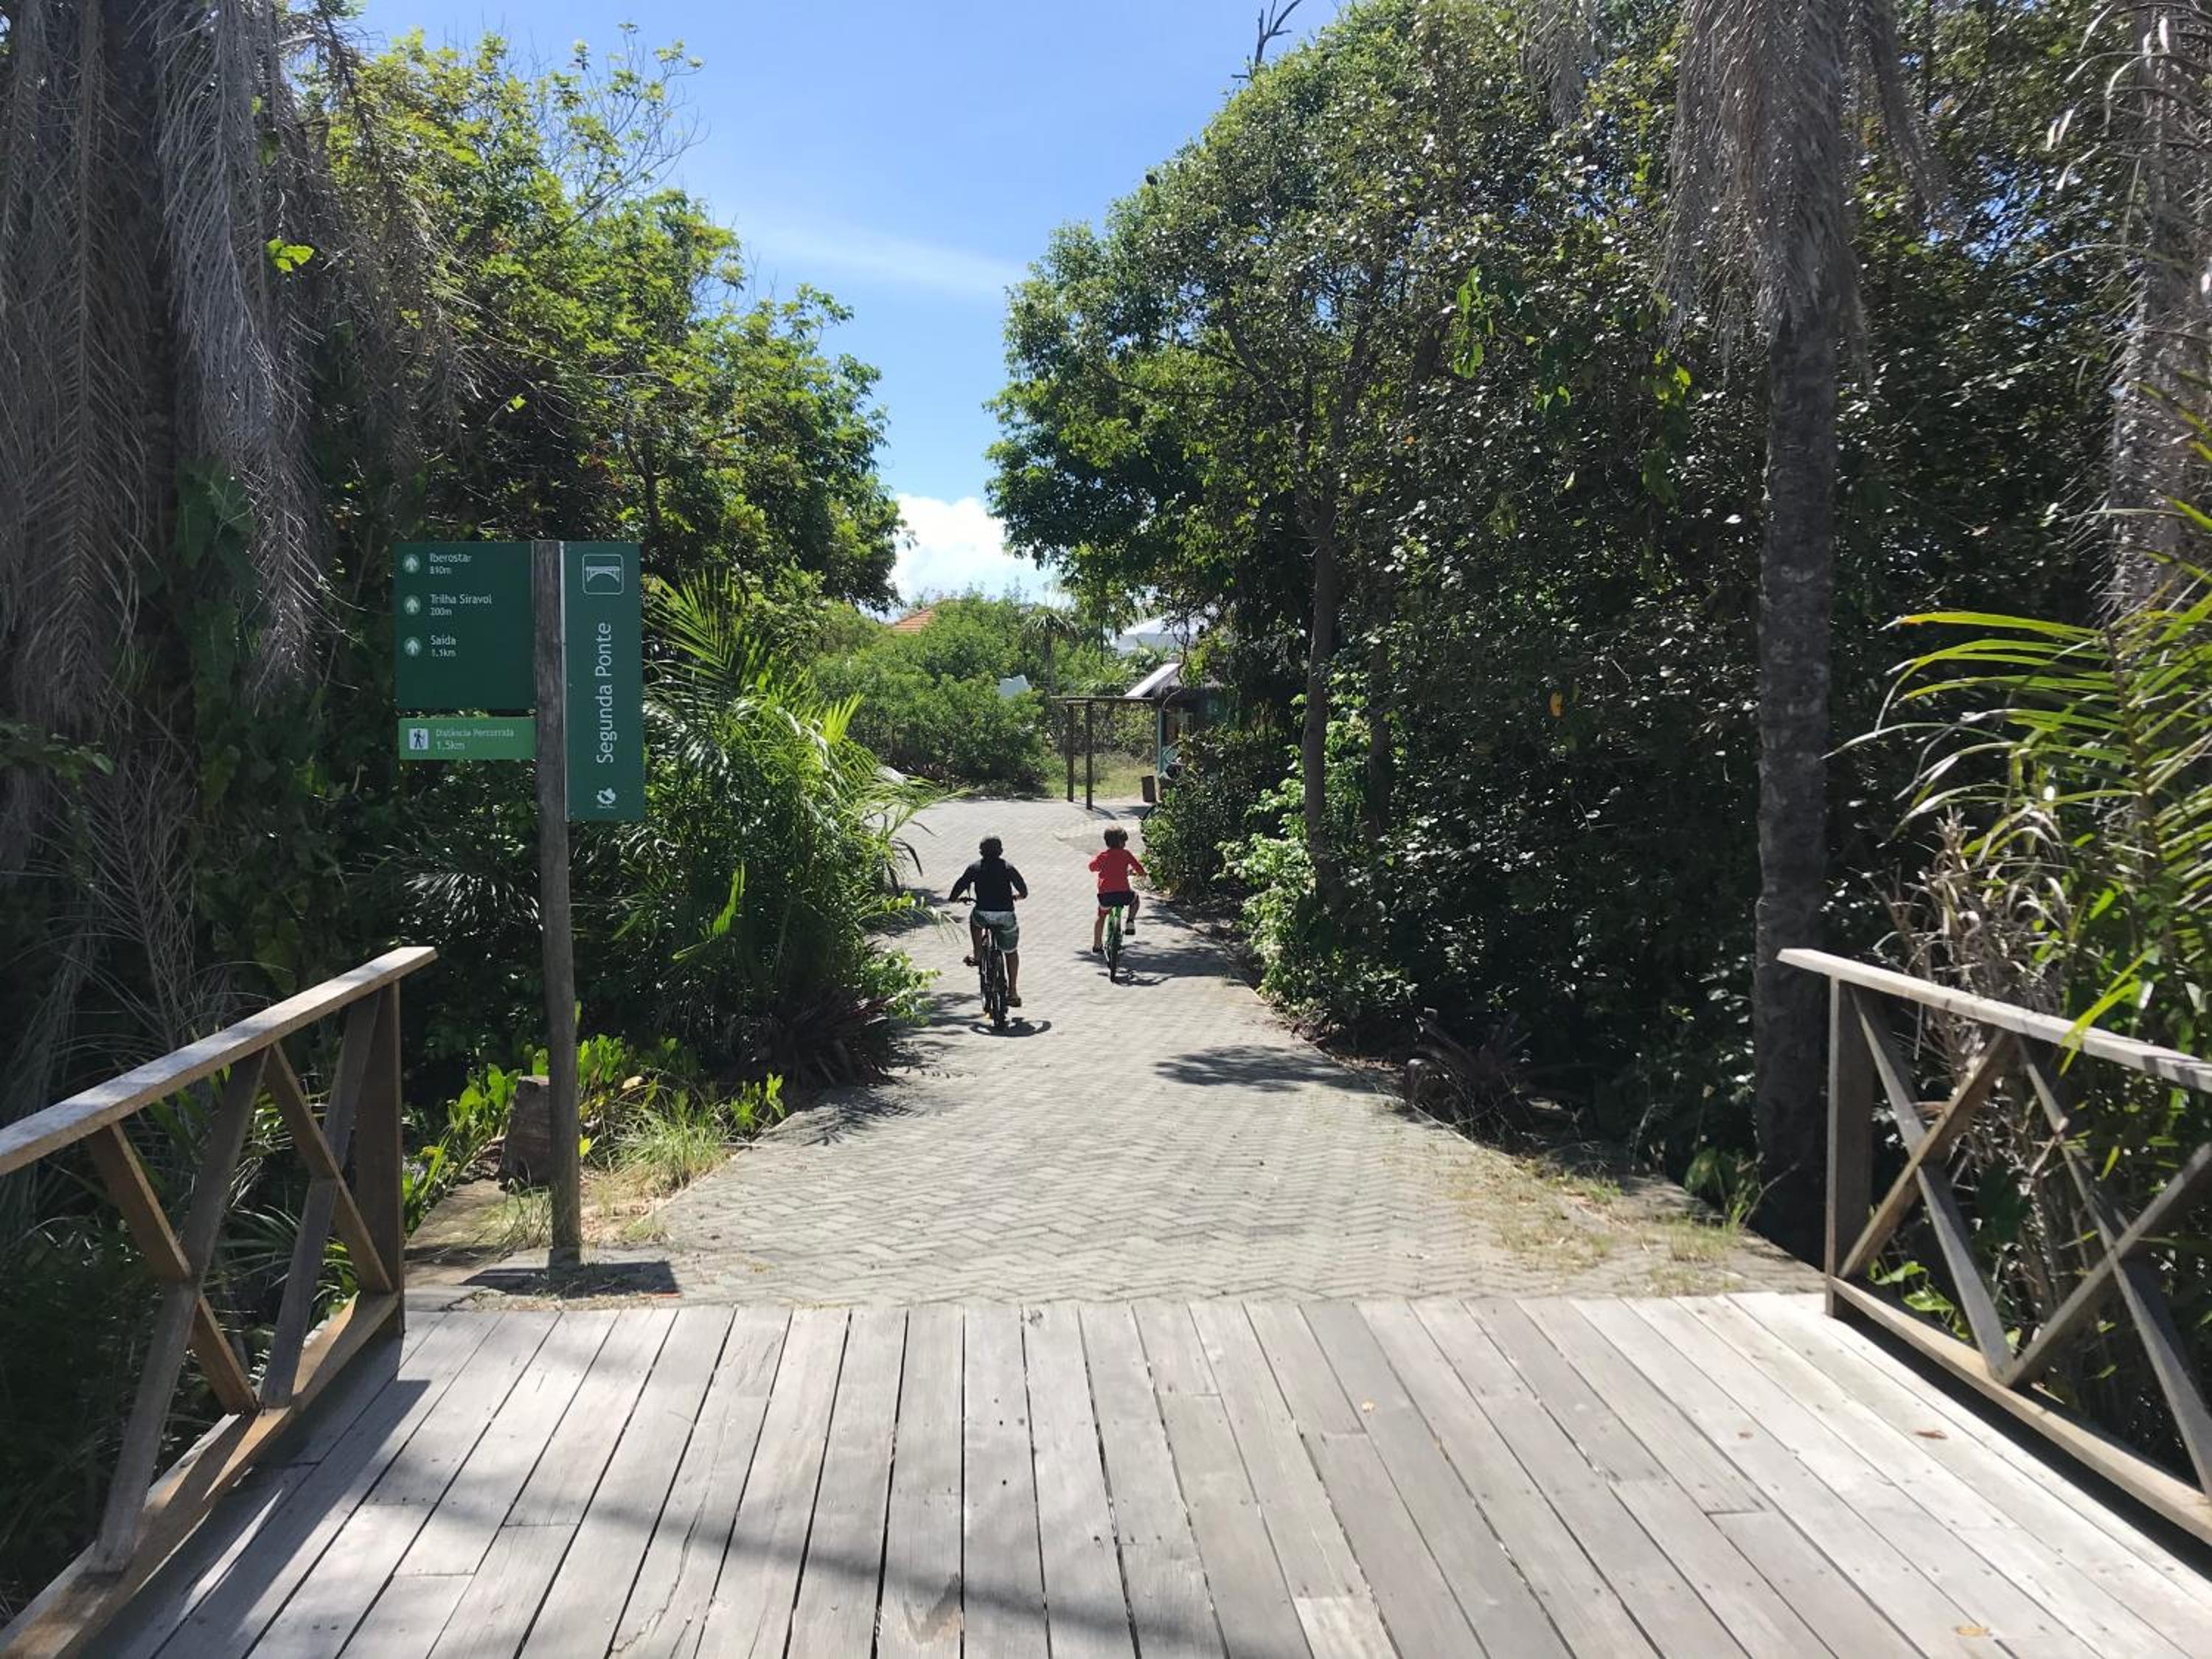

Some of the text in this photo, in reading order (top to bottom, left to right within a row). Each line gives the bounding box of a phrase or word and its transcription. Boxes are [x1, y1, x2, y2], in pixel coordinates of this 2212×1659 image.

[430, 553, 473, 563] Iberostar
[430, 594, 456, 604] Trilha
[430, 607, 452, 616] 200m
[595, 622, 617, 763] Segunda Ponte
